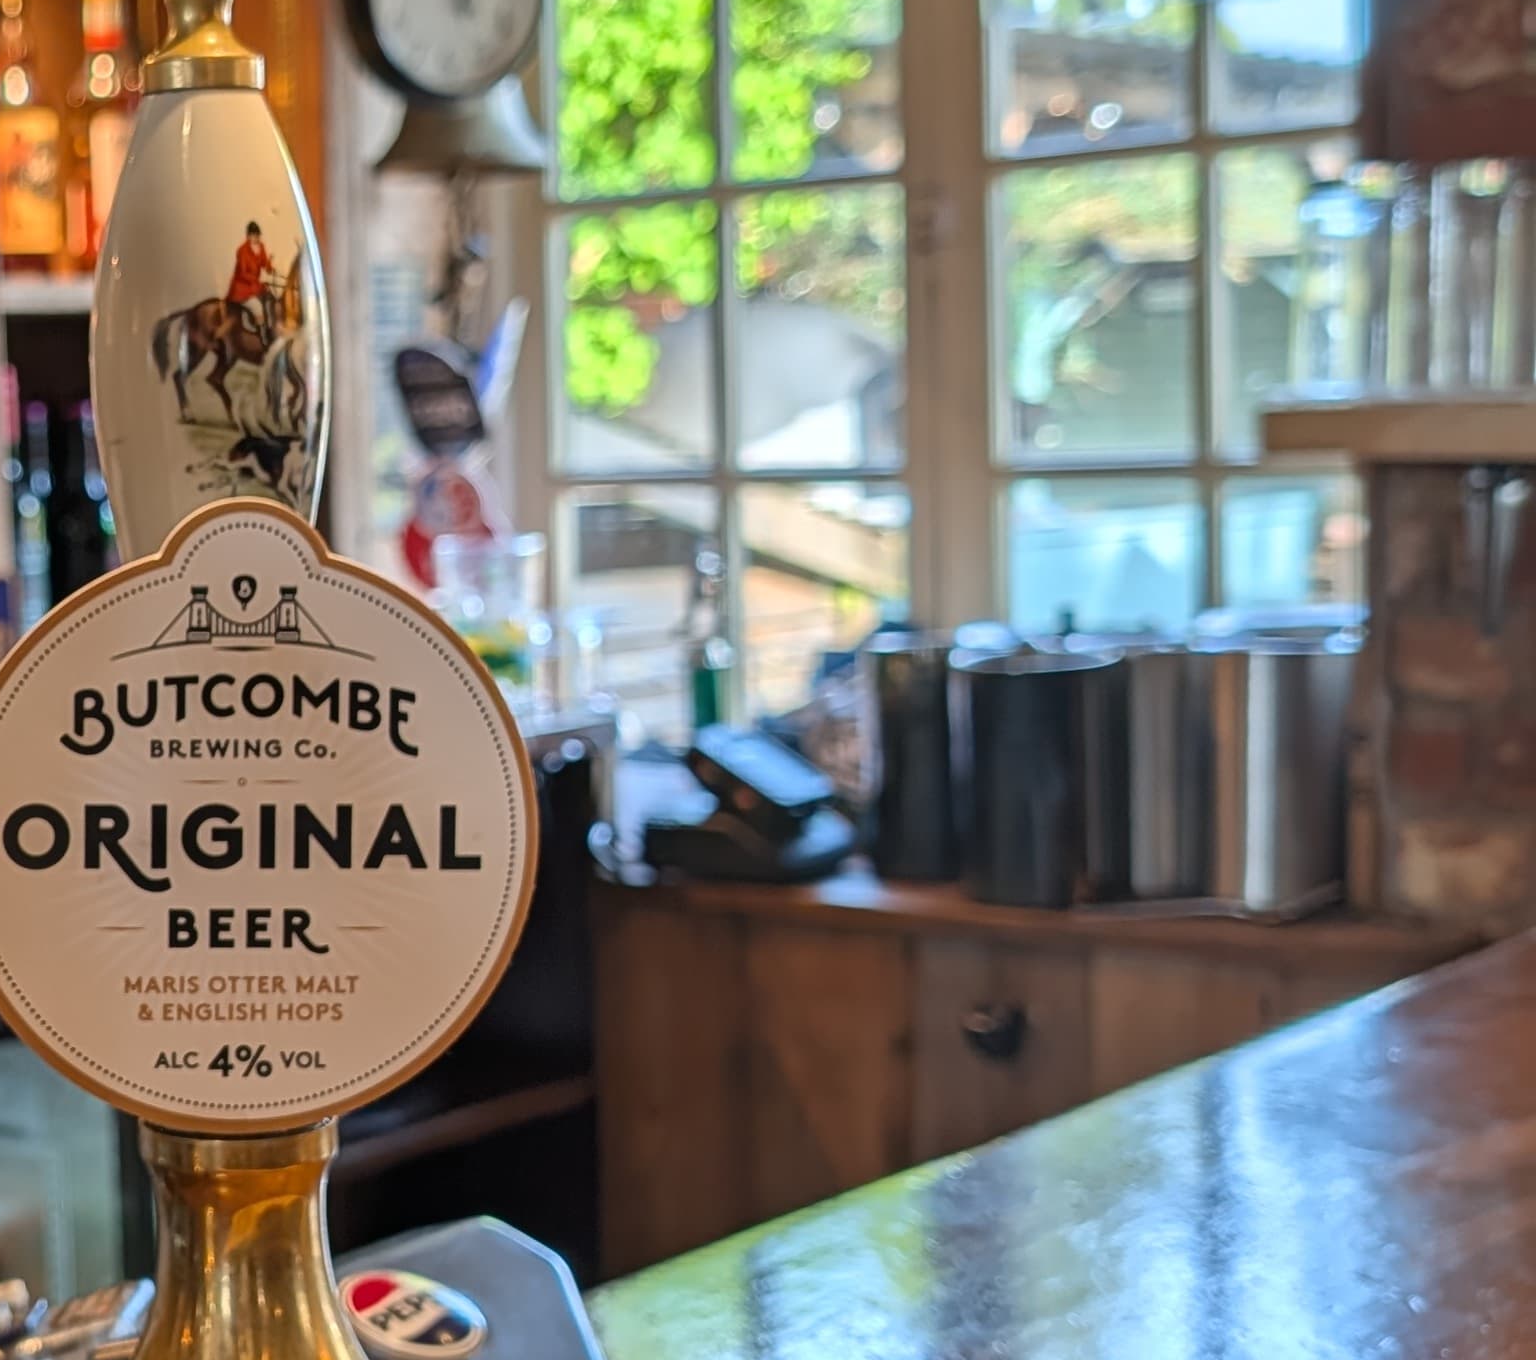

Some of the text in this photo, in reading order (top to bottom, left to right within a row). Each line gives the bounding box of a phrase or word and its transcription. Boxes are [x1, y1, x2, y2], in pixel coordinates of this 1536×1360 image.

[59, 673, 419, 757] BUTCOMBE
[150, 738, 338, 759] BREWING Co.
[2, 803, 482, 893] ORIGINAL
[168, 908, 330, 954] BEER
[124, 975, 360, 994] MARIS OTTER MALT
[137, 1002, 344, 1021] & ENGLISH HOPS
[154, 1044, 327, 1078] ALC 4% VOL
